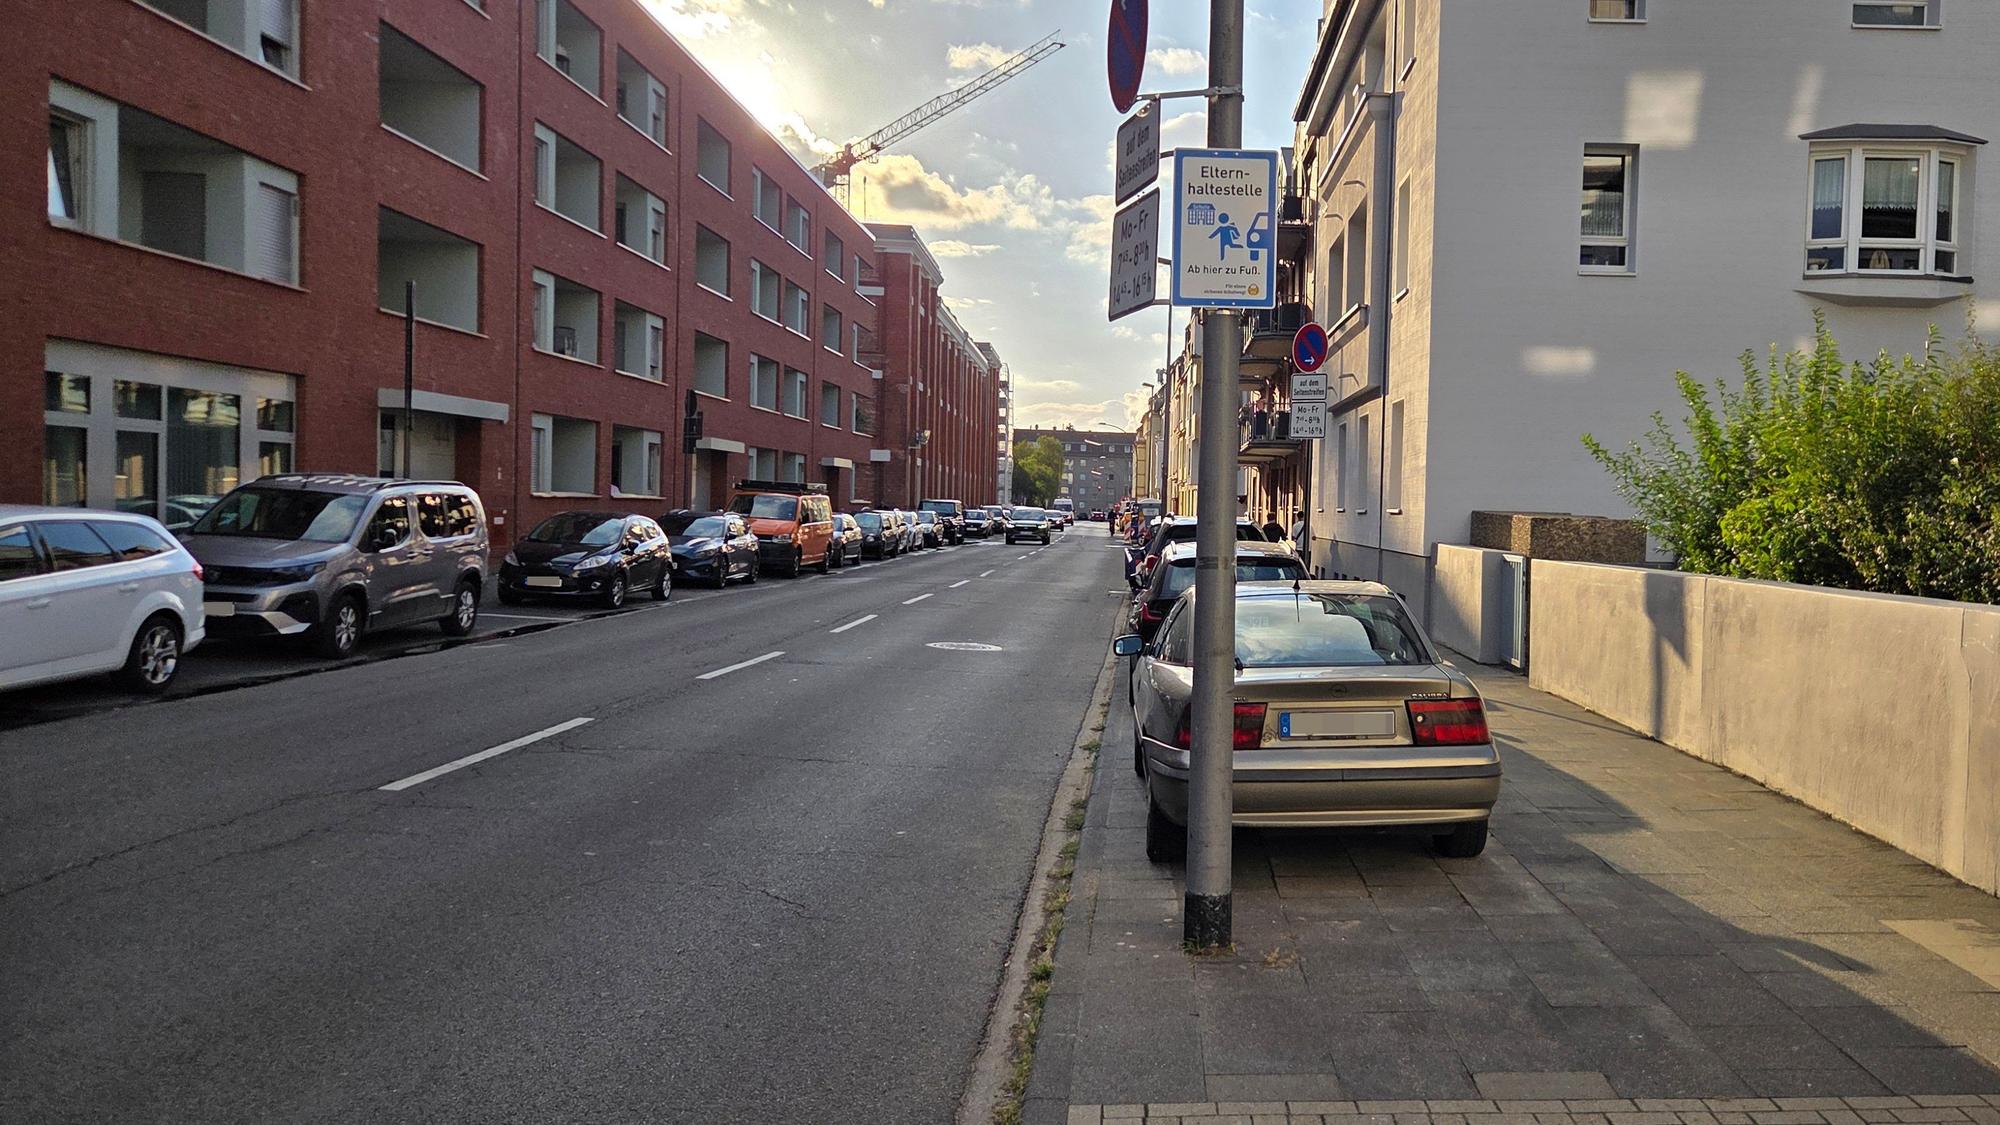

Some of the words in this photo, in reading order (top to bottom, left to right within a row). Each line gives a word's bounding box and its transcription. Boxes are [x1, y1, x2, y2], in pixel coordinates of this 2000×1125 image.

[1201, 166, 1250, 179] Eltern-
[1188, 182, 1262, 196] haltestelle
[1187, 264, 1200, 274] Ab
[1203, 264, 1223, 275] hier
[1225, 267, 1237, 275] zu
[1240, 265, 1261, 275] Fuß.
